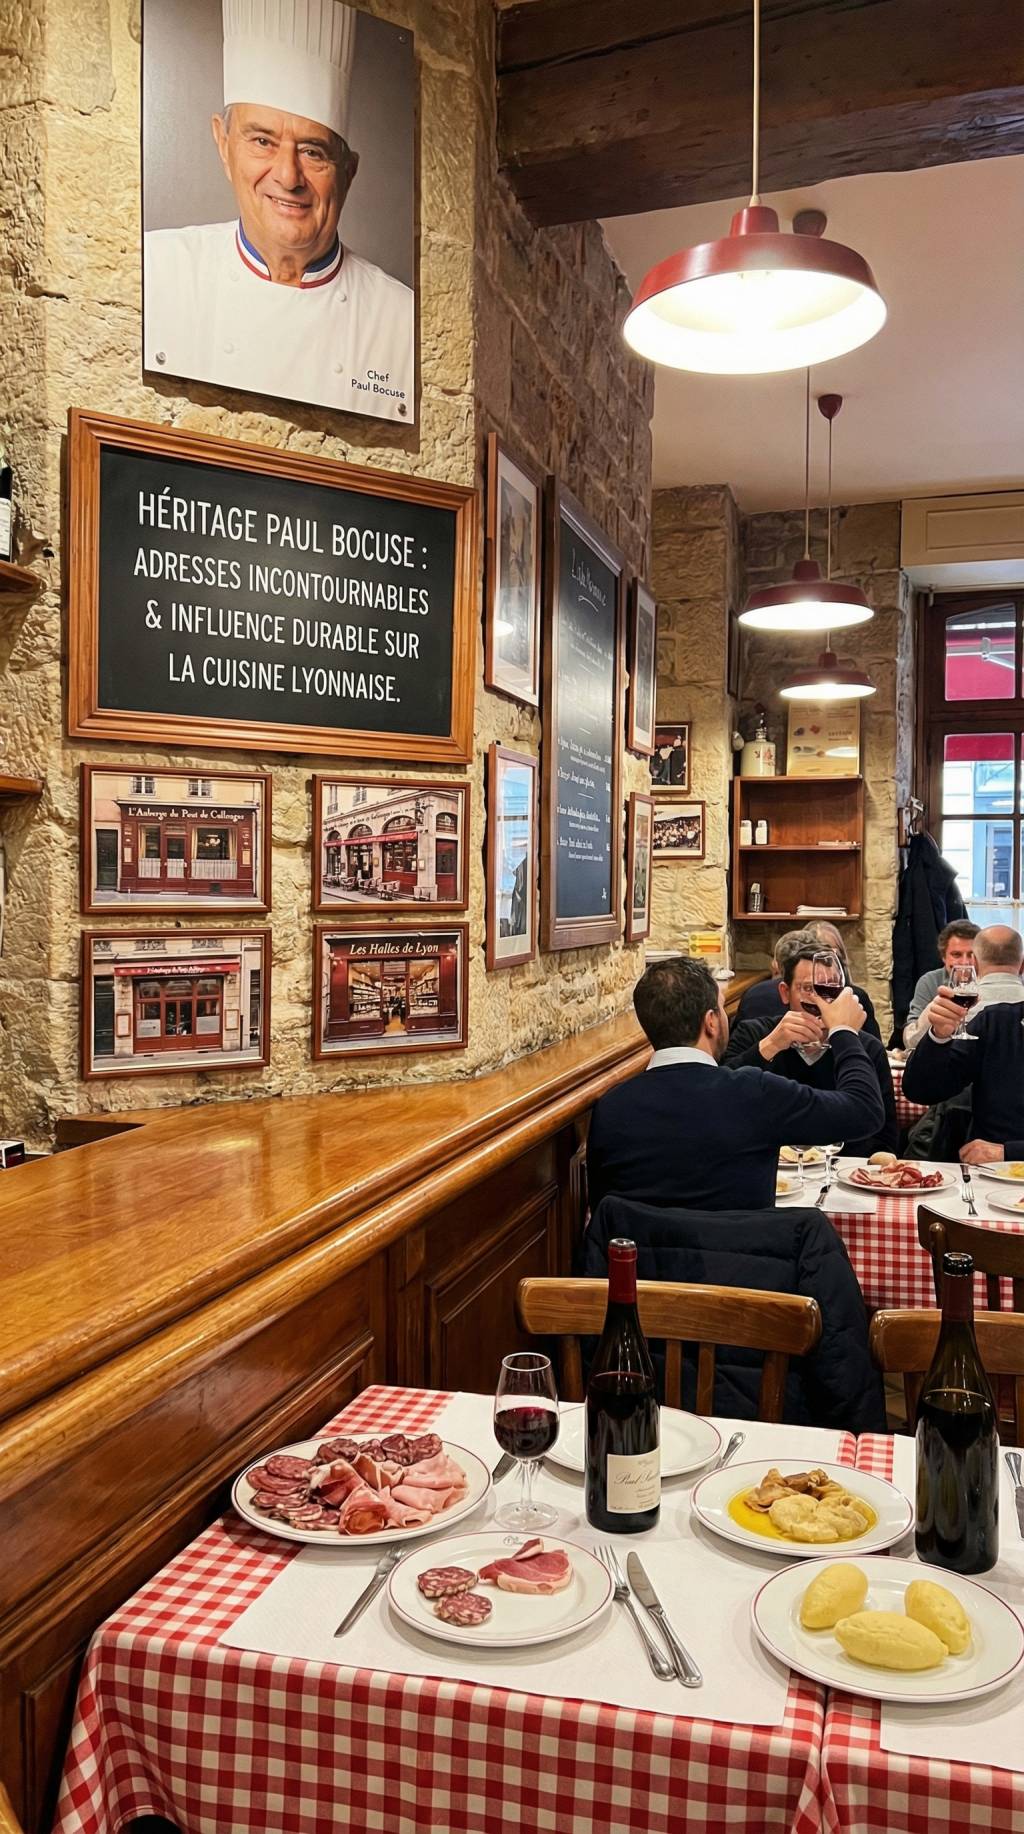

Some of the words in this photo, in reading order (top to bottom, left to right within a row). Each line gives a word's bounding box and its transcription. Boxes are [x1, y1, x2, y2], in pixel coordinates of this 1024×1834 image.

[351, 378, 371, 391] Paul
[373, 383, 405, 399] Bocuse
[367, 370, 390, 382] Chef
[139, 486, 258, 543] HÉRITAGE
[266, 513, 324, 554] PAUL
[332, 524, 415, 568] BOCUSE
[422, 547, 428, 570] :
[133, 547, 242, 590] ADRESSES
[249, 563, 430, 615] INCONTOURNABLES
[145, 599, 163, 629] &
[171, 602, 286, 644] INFLUENCE
[292, 618, 379, 655] DURABLE
[384, 629, 420, 659] SUR
[169, 652, 196, 683] LA
[202, 656, 285, 692] CUISINE
[292, 665, 401, 703] LYONNAISE.
[199, 810, 208, 819] de
[349, 944, 367, 955] Les
[369, 943, 400, 954] Halles
[402, 943, 414, 953] de
[415, 942, 439, 956] Lyon
